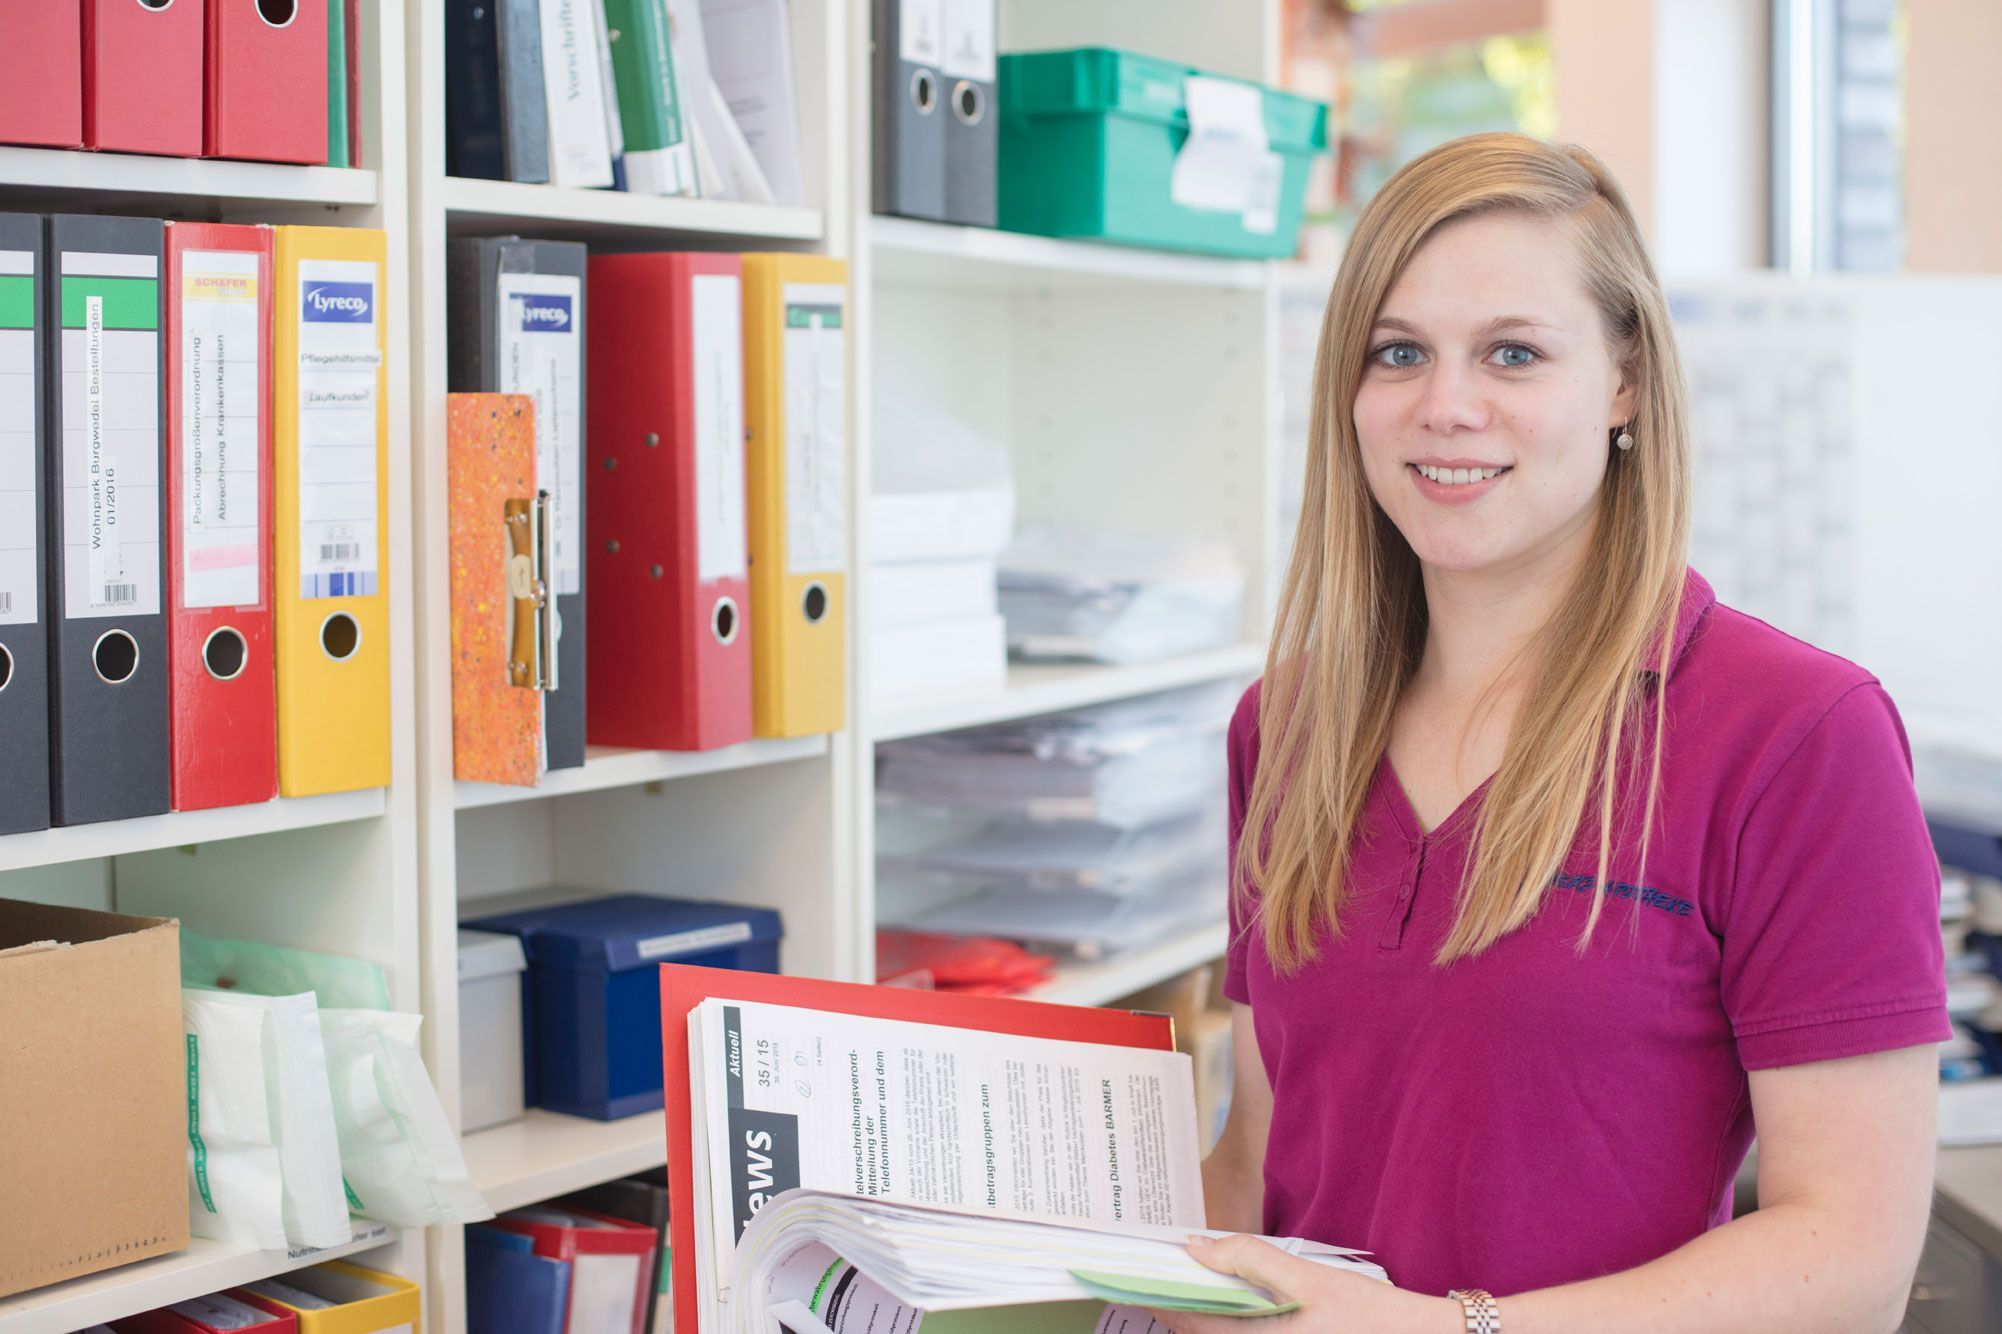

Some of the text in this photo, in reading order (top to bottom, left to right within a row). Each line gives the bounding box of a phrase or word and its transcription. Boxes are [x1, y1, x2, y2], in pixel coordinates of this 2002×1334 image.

[311, 290, 366, 315] Lyreco
[89, 303, 103, 550] Wohnpark Burgwedel Bestellungen
[215, 334, 228, 521] Abrechnung Krankenkassen
[105, 468, 117, 525] 01/2016
[728, 1030, 741, 1079] Aktuell
[757, 1040, 769, 1056] 15
[758, 1070, 771, 1087] 35
[1101, 1079, 1115, 1130] BARMER
[874, 1050, 891, 1195] Telefonnummer und dem
[980, 1084, 997, 1208] tbetragsgruppen zum
[743, 1129, 774, 1228] ews
[864, 1115, 878, 1196] Mitteilung der
[1107, 1133, 1120, 1182] Diabetes
